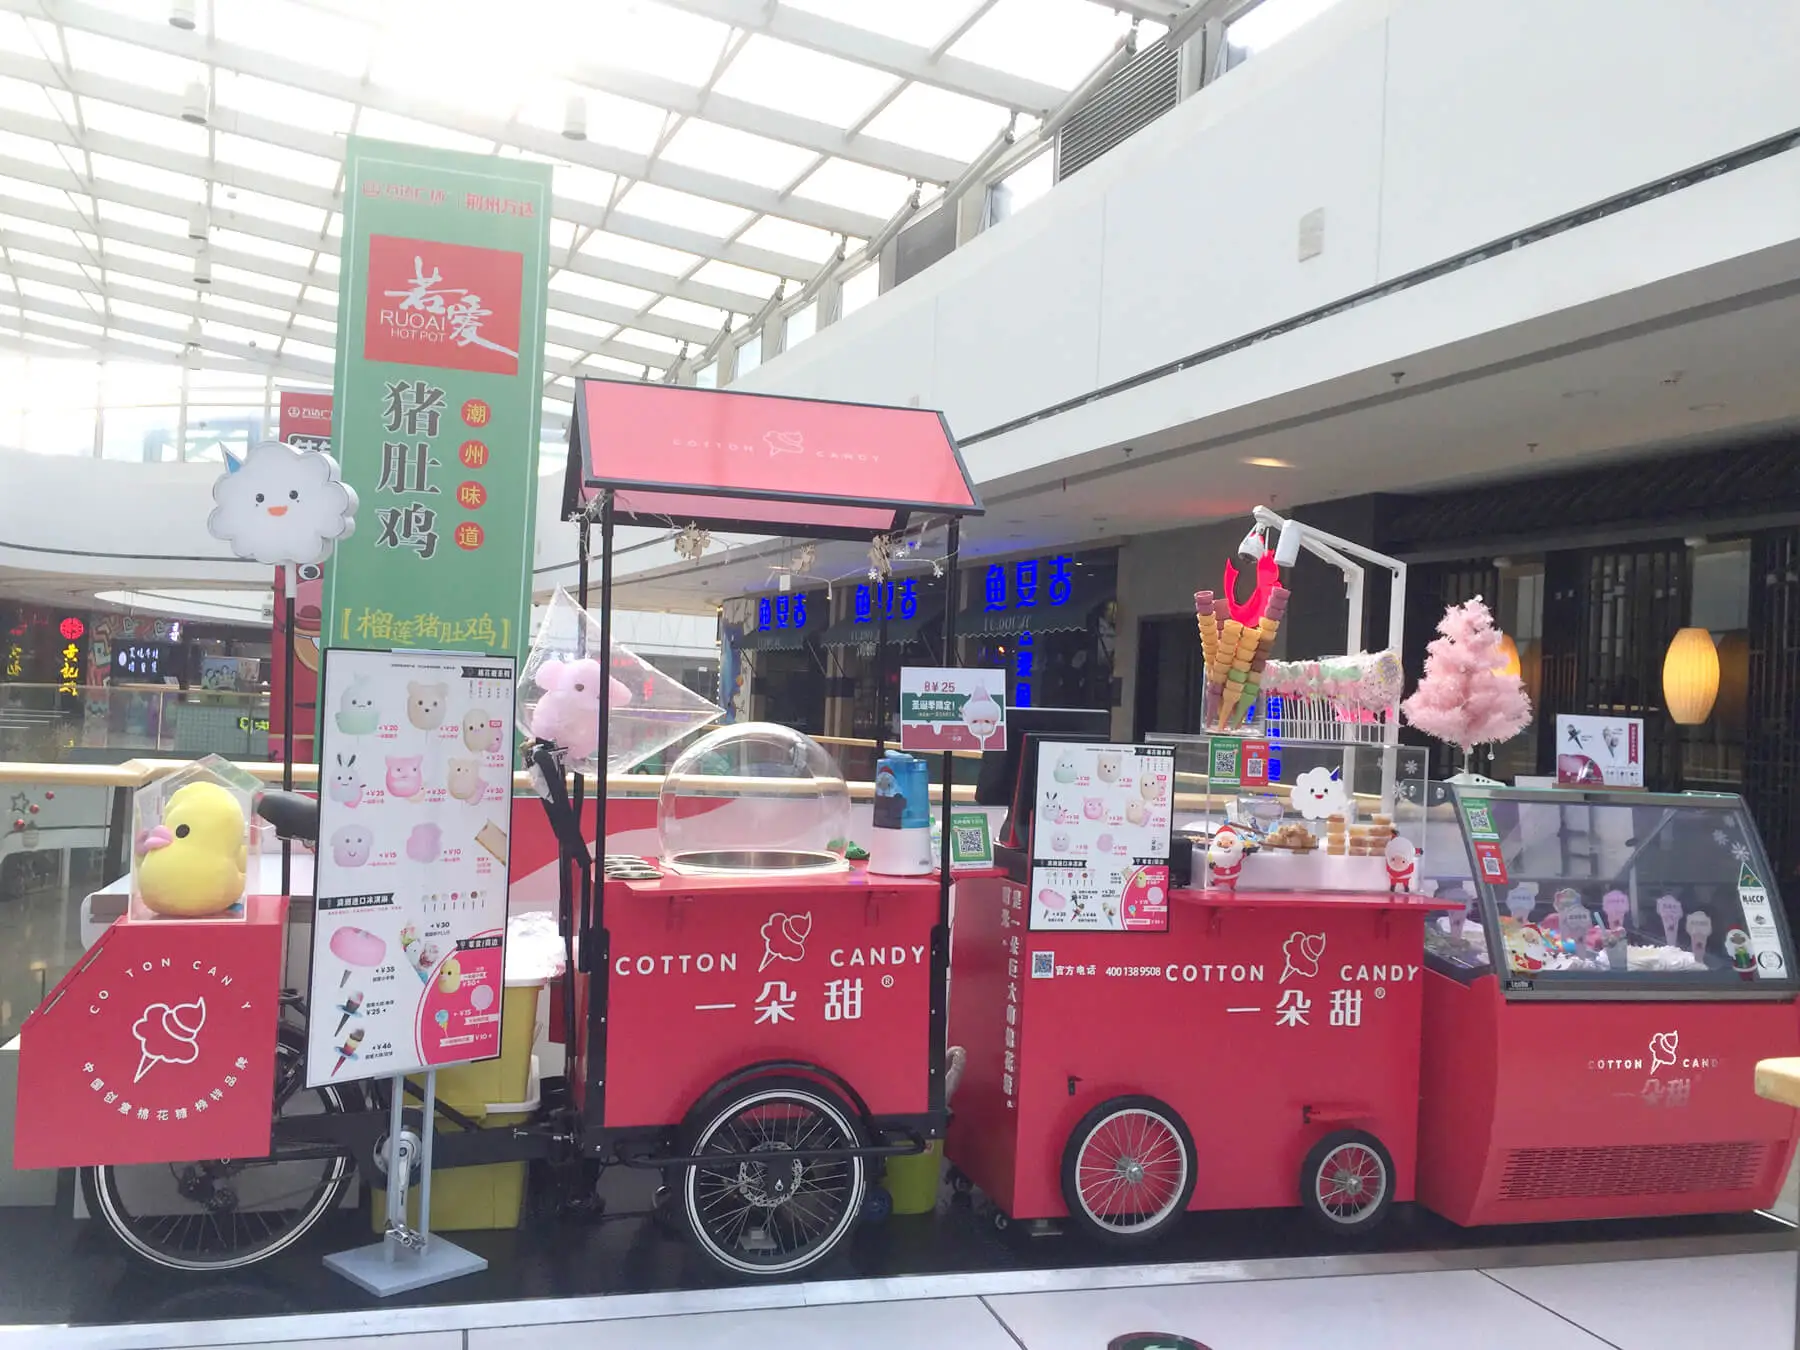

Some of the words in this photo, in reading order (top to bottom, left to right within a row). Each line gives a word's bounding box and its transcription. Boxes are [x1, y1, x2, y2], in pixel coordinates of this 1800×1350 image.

[380, 309, 445, 330] RUOAI
[391, 328, 418, 339] HOT
[421, 331, 446, 342] POT
[672, 438, 756, 454] COTTON
[815, 449, 881, 463] CANDY
[374, 380, 448, 559] 猪肚鸡
[459, 403, 486, 547] 潮州味道
[615, 953, 738, 976] COTTON
[830, 946, 925, 967] CANDY
[1055, 964, 1097, 976] 官方电话
[1165, 964, 1264, 982] COTTON
[1340, 964, 1420, 982] CANDY
[695, 978, 863, 1025] 一朵甜
[1226, 989, 1363, 1027] 一朵甜
[1588, 1059, 1642, 1070] COTTON
